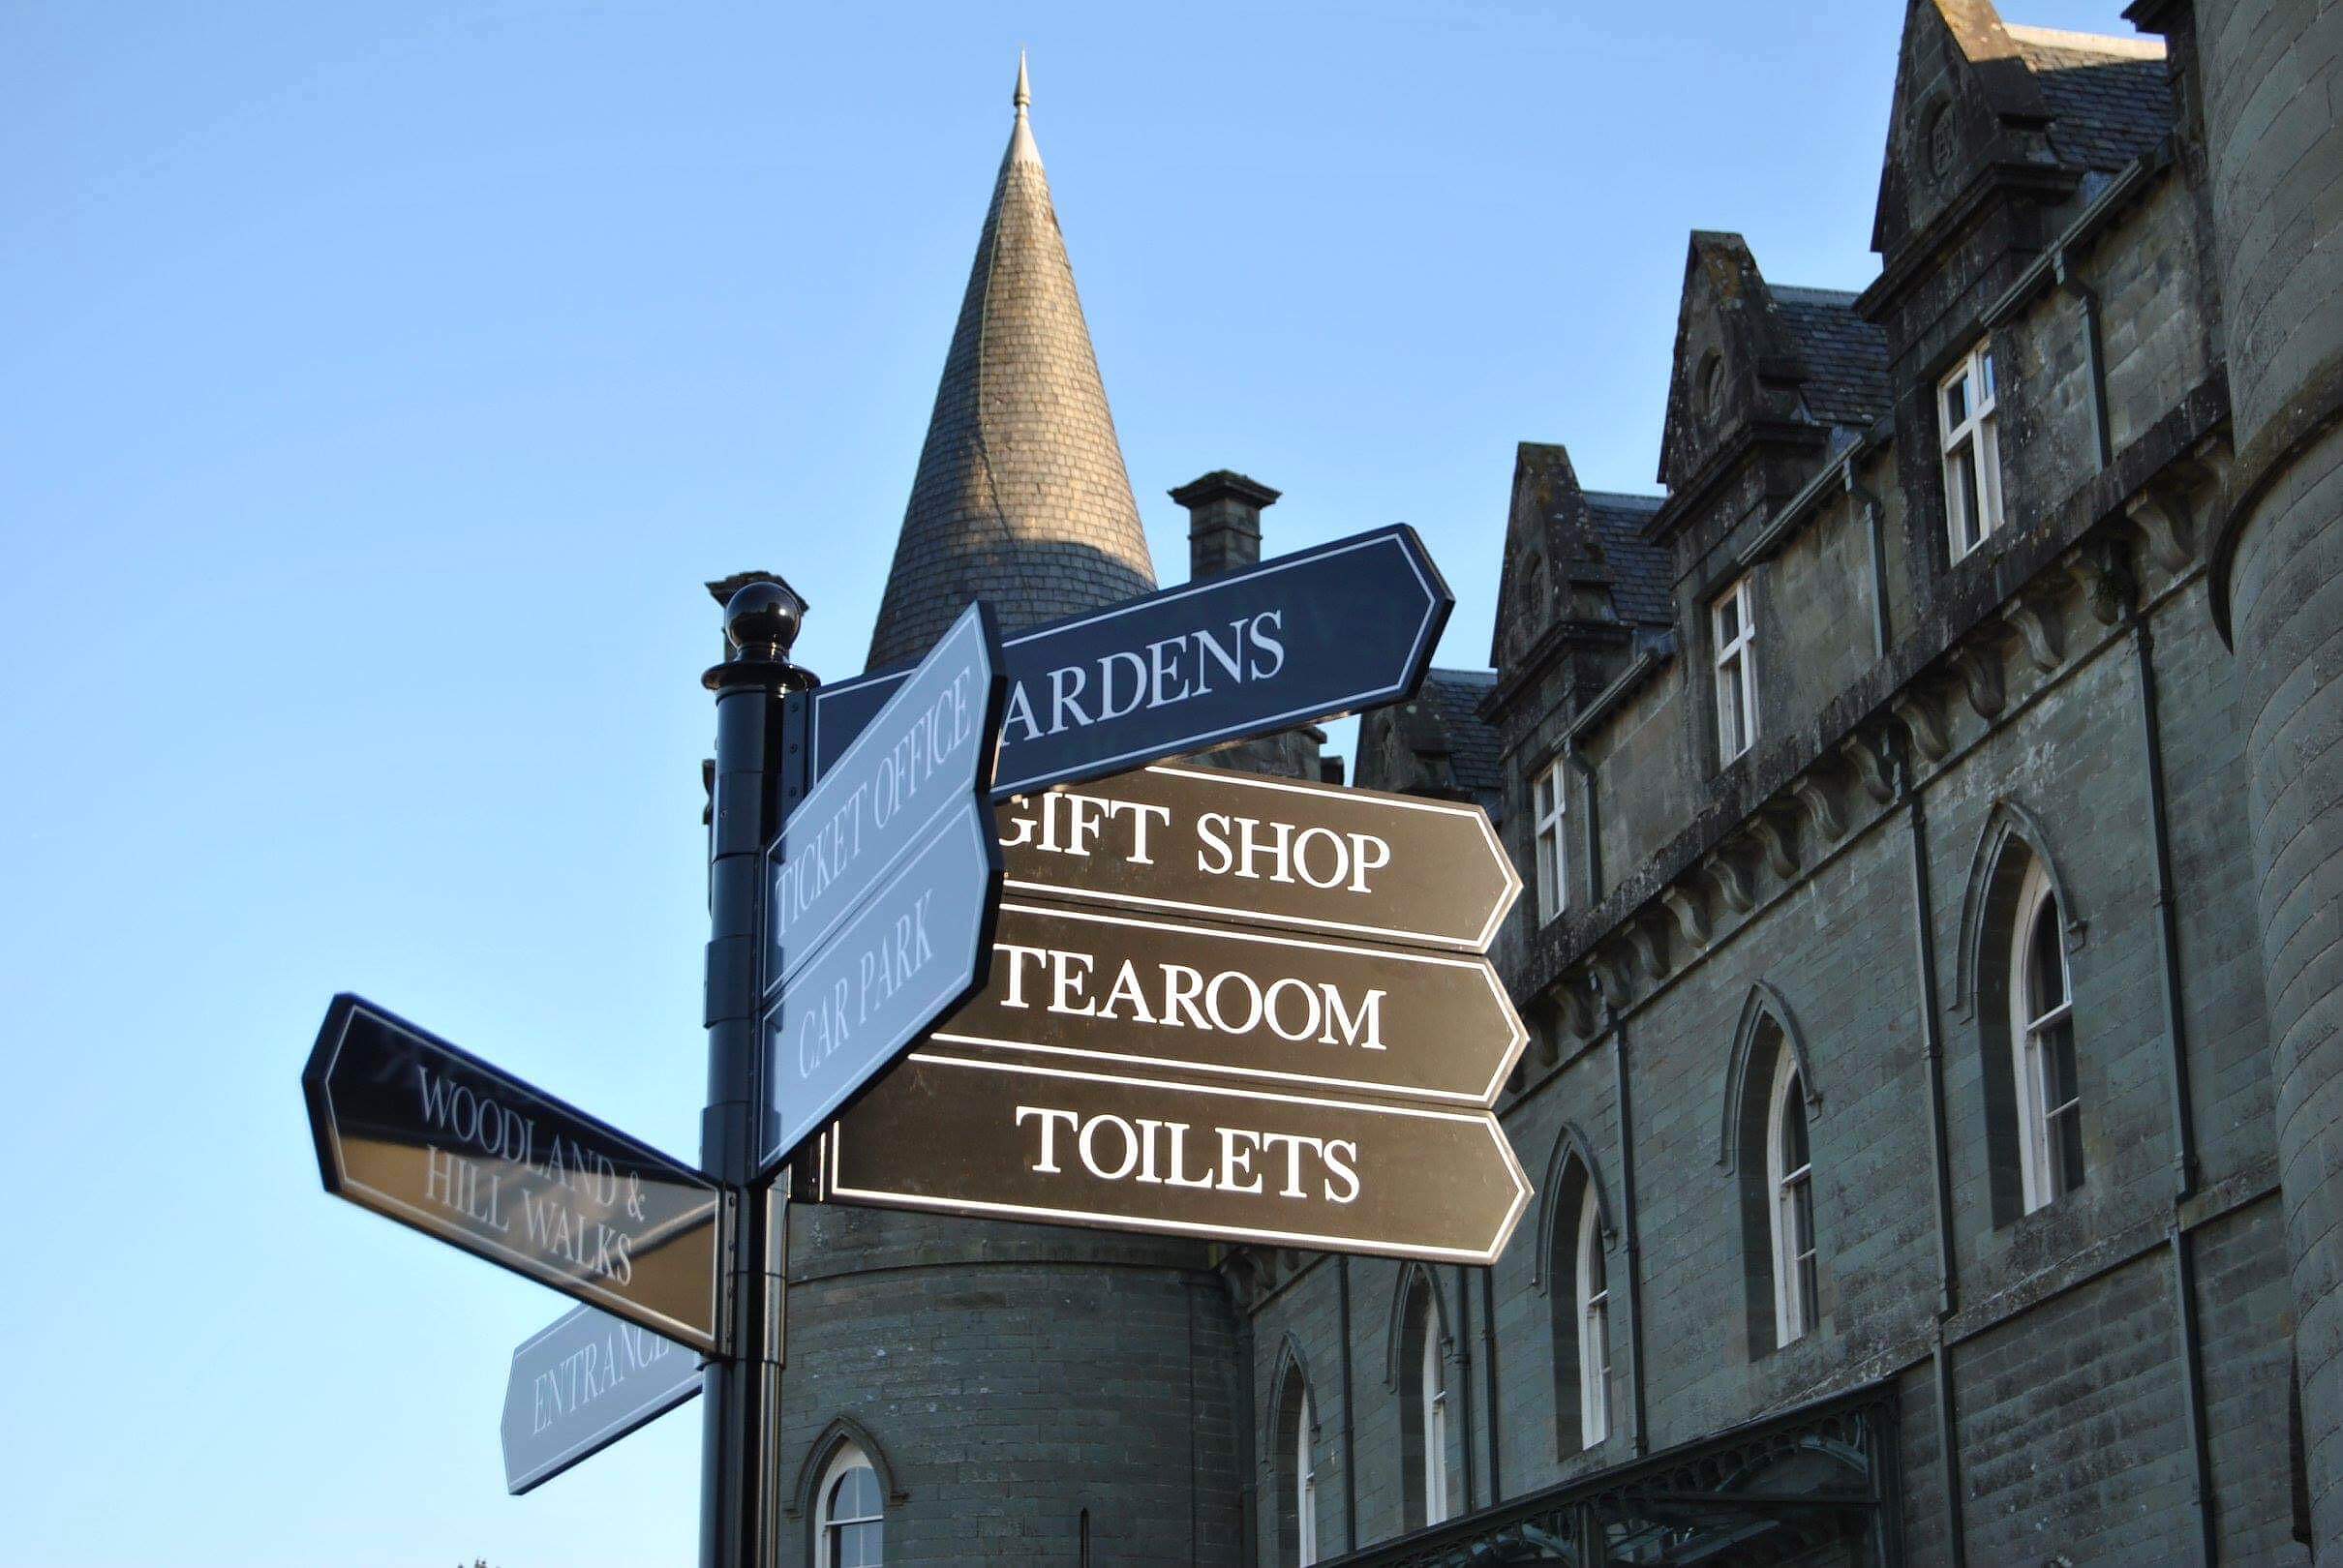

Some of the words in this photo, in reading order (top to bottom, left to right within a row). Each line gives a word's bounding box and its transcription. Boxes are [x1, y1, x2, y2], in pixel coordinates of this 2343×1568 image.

[998, 609, 1285, 747] ARDENS
[776, 786, 867, 939] TICKET
[873, 666, 971, 827] OFFICE
[1197, 813, 1390, 893] SHOP
[798, 977, 849, 1079] CAR
[858, 890, 935, 1025] PARK
[992, 943, 1386, 1050] TEAROOM
[419, 1067, 616, 1207] WOODLAND
[626, 1170, 645, 1221] &
[1016, 1105, 1361, 1203] TOILETS
[425, 1145, 509, 1232] HILL
[523, 1191, 632, 1286] WALKS
